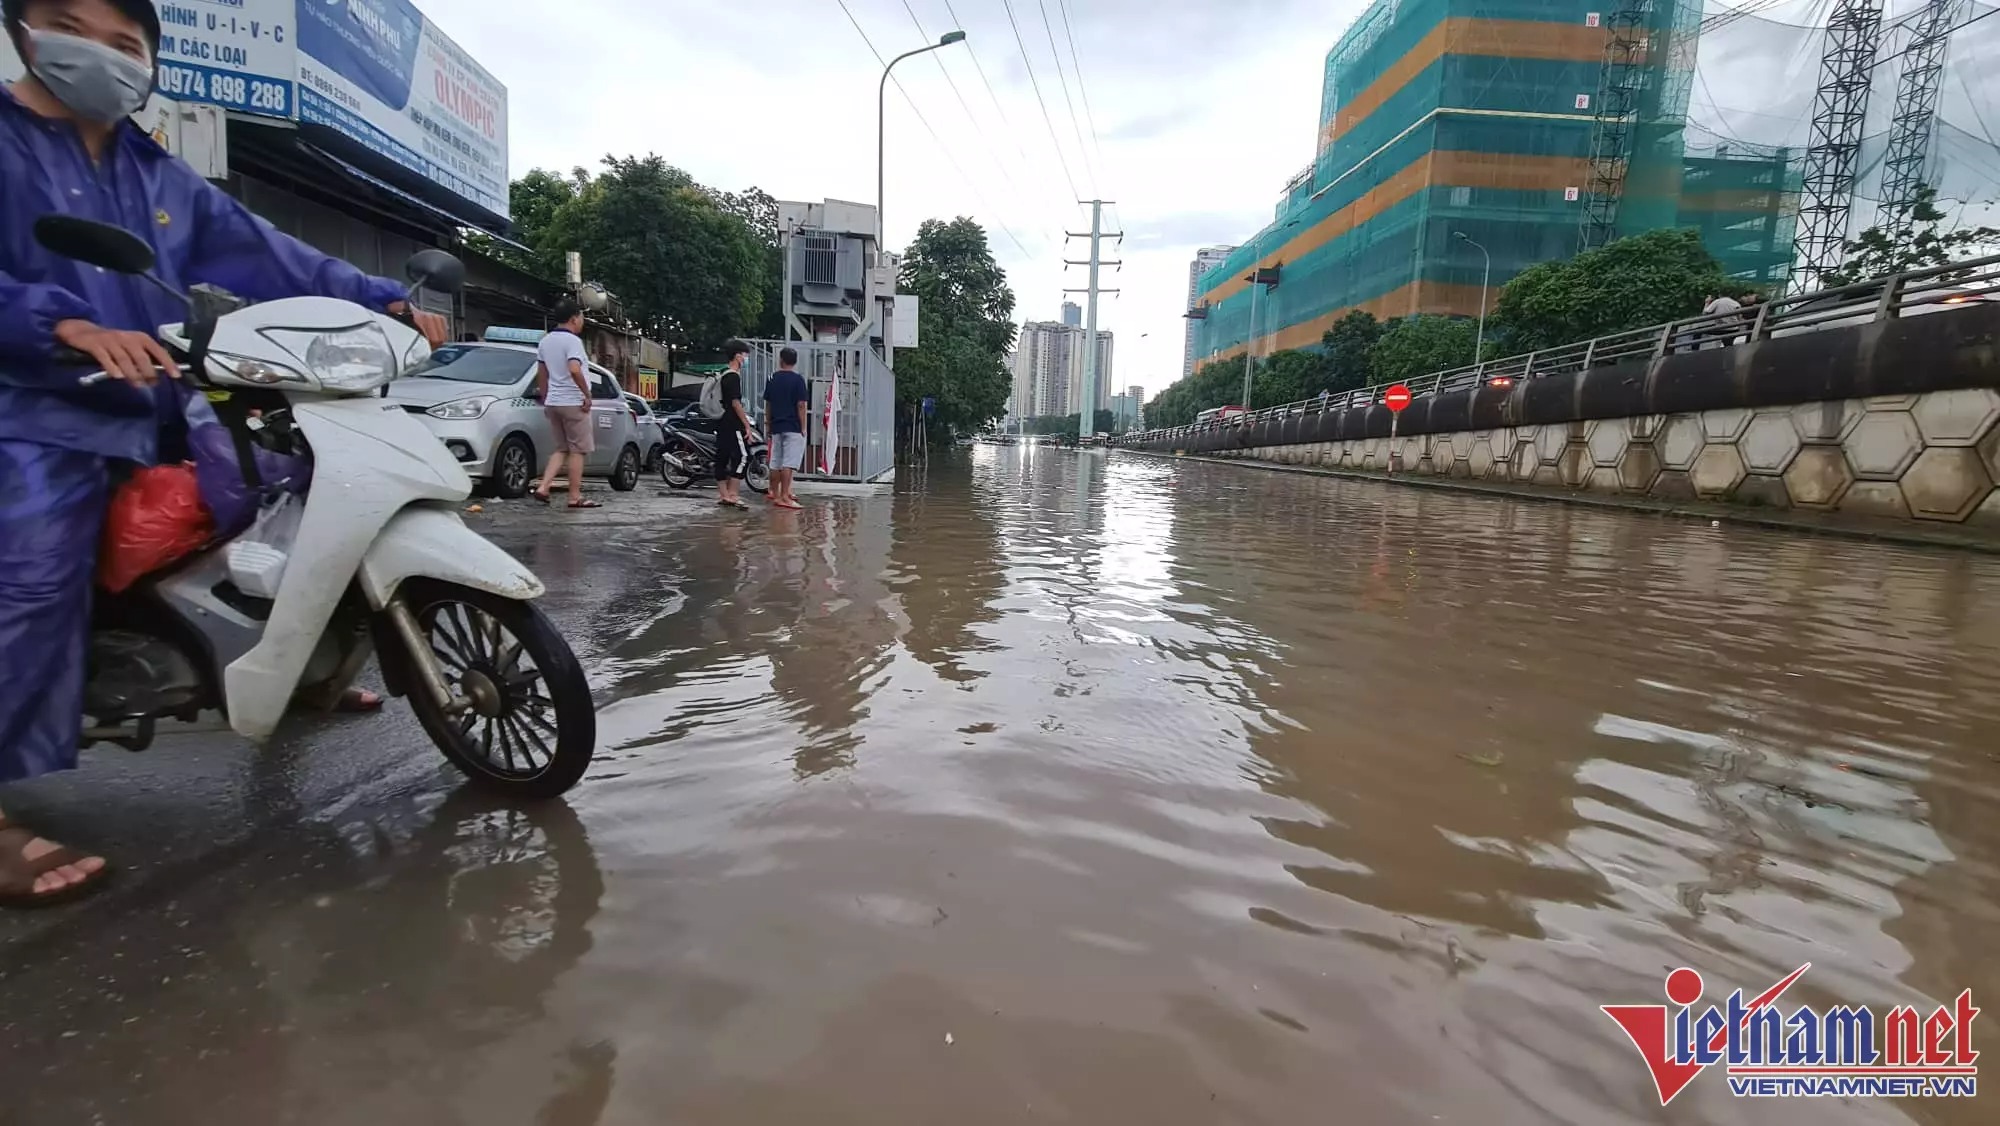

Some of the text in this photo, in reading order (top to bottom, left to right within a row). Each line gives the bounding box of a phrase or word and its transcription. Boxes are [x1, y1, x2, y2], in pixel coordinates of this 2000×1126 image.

[161, 4, 197, 27] HÌNH
[180, 36, 210, 59] CÁC
[214, 44, 247, 68] LOẠI
[157, 65, 285, 111] 0974 898 288
[434, 69, 495, 139] OLYMPIC
